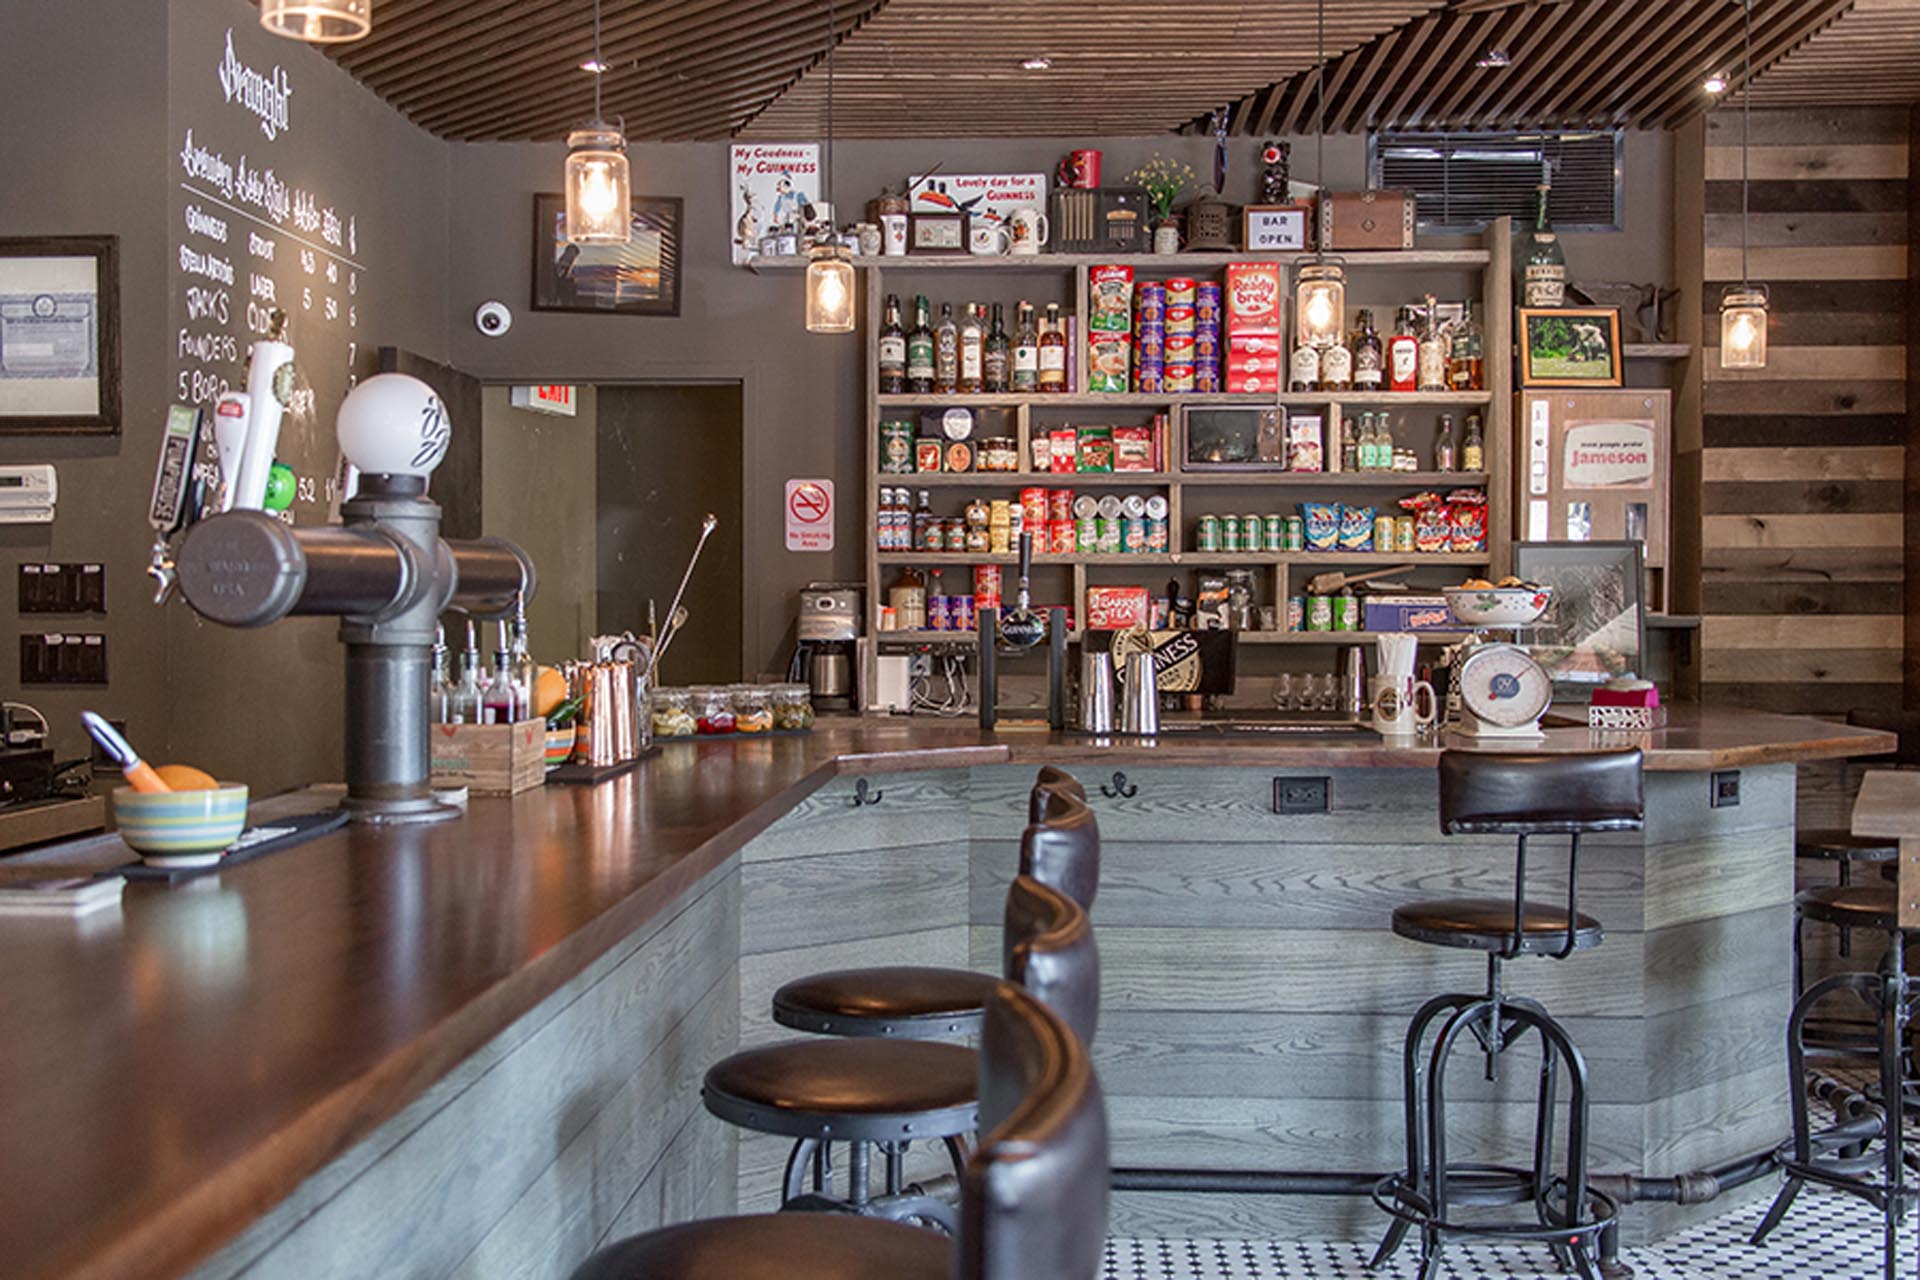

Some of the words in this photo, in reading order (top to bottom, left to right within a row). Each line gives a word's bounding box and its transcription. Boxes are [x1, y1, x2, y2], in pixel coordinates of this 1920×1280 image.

[218, 26, 292, 140] Draught
[735, 148, 751, 161] My
[754, 147, 804, 159] Goodness
[737, 163, 753, 177] My
[756, 160, 816, 174] GUINNESS
[956, 176, 987, 188] Lovely
[990, 177, 1008, 187] day
[1011, 175, 1025, 186] for
[1029, 178, 1036, 186] a
[986, 189, 1035, 201] GUINNESS
[1261, 216, 1288, 226] BAR
[1258, 234, 1293, 244] OPEN
[1571, 451, 1648, 467] Jameson
